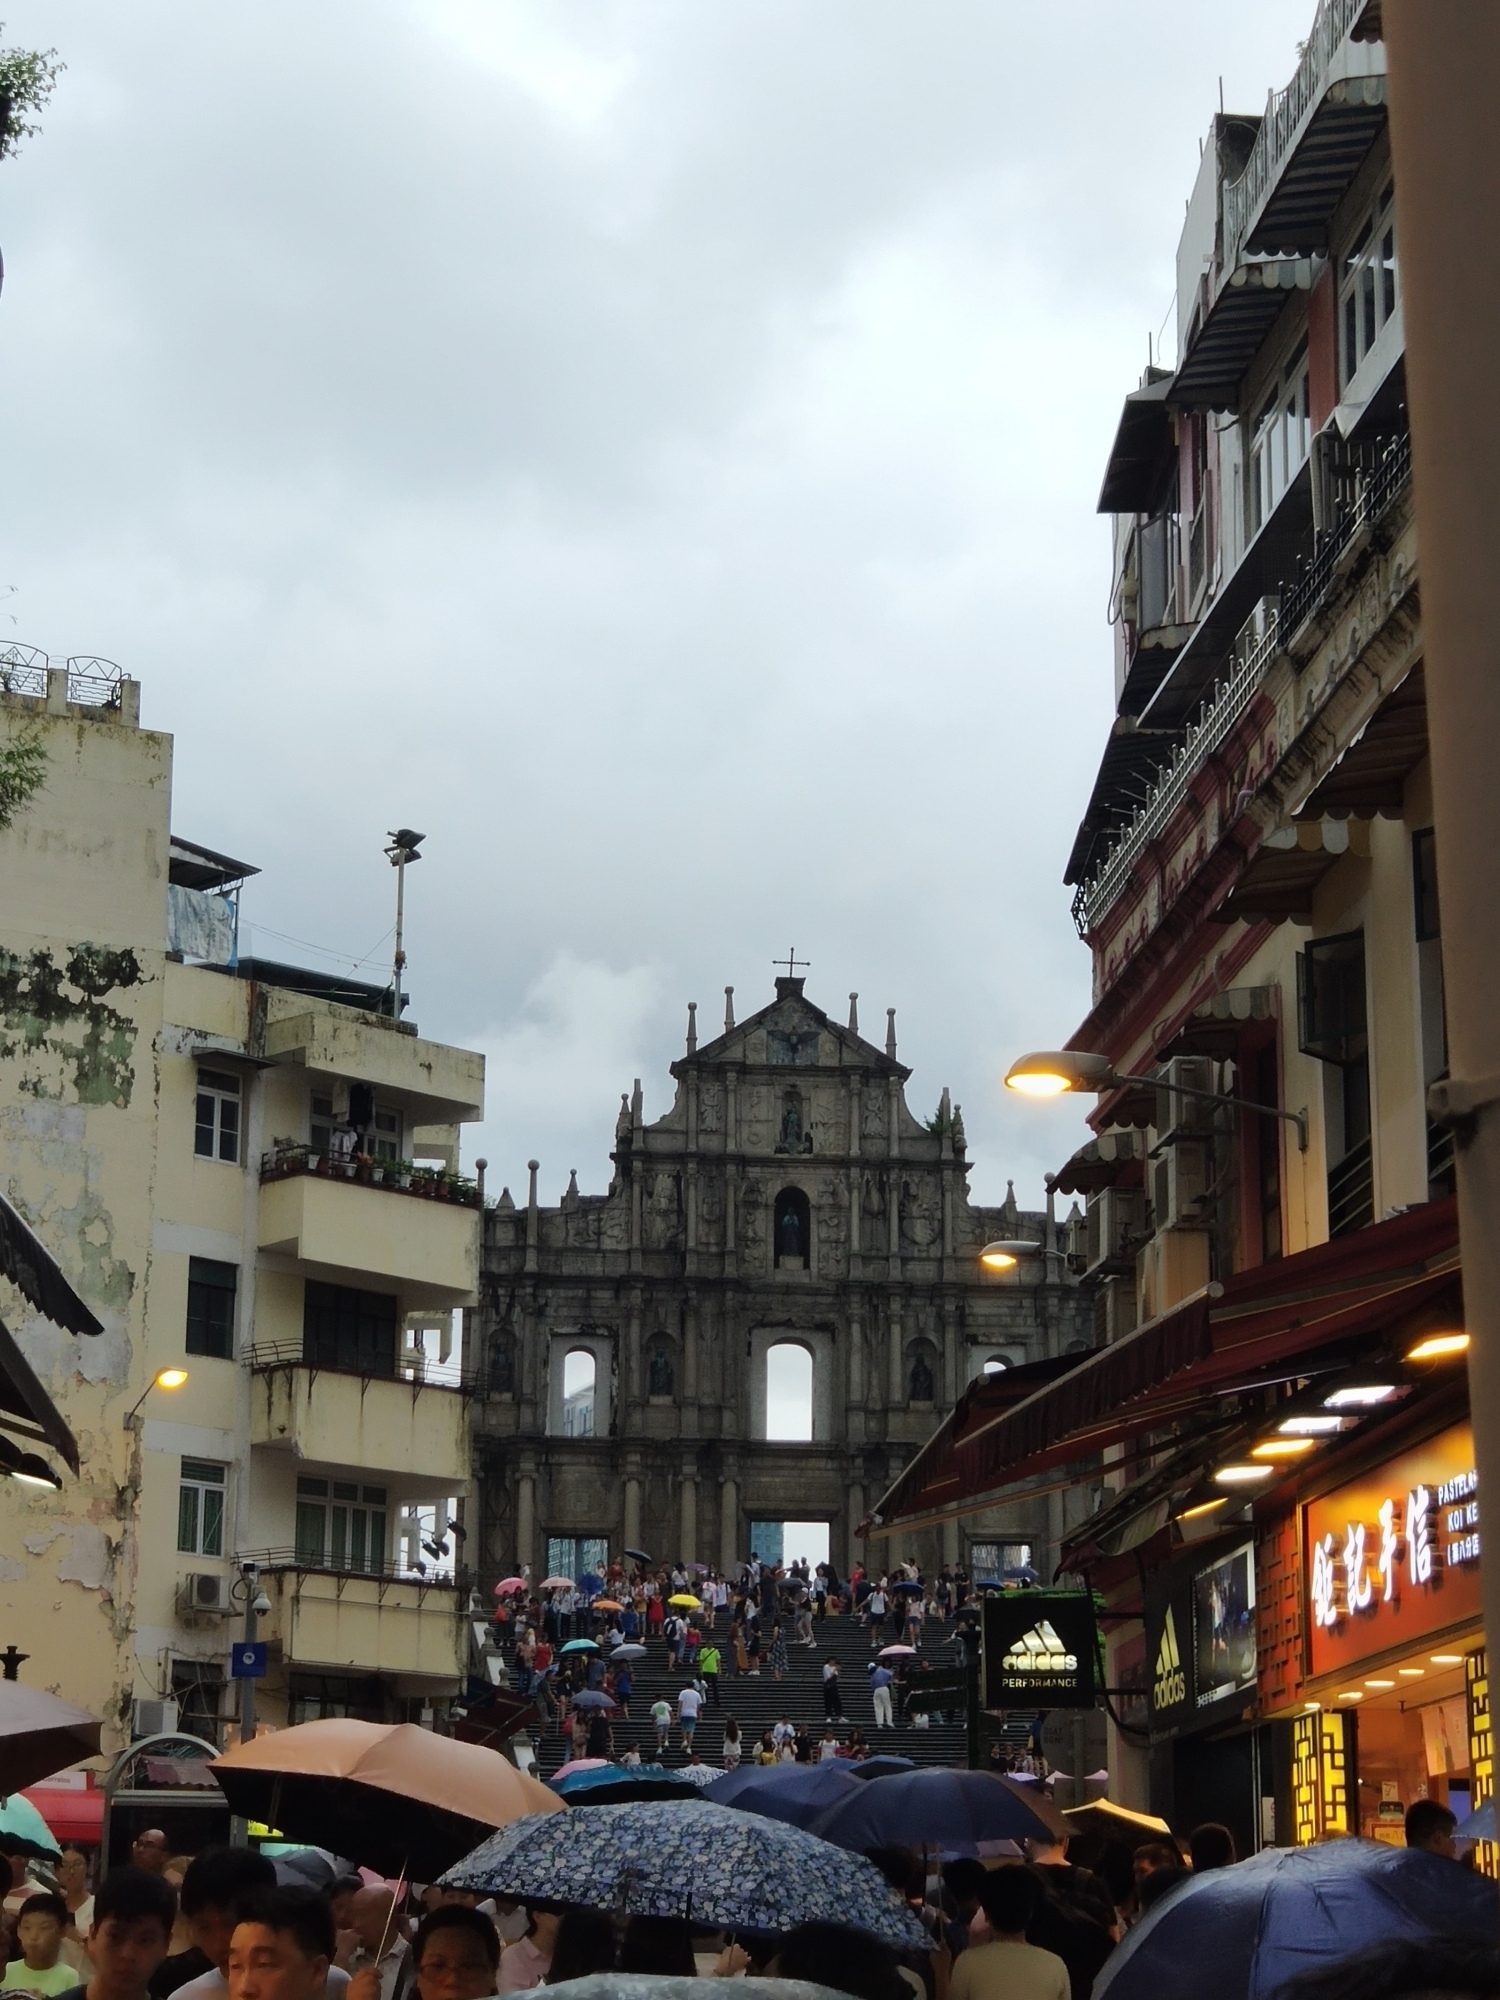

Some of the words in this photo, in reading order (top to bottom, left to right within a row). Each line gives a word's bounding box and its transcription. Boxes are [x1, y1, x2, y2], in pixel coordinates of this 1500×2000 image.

[1448, 1509, 1463, 1532] KOI
[1002, 1651, 1078, 1670] adidas
[1002, 1678, 1078, 1688] PERFORMANCE
[1154, 1668, 1185, 1710] adidas
